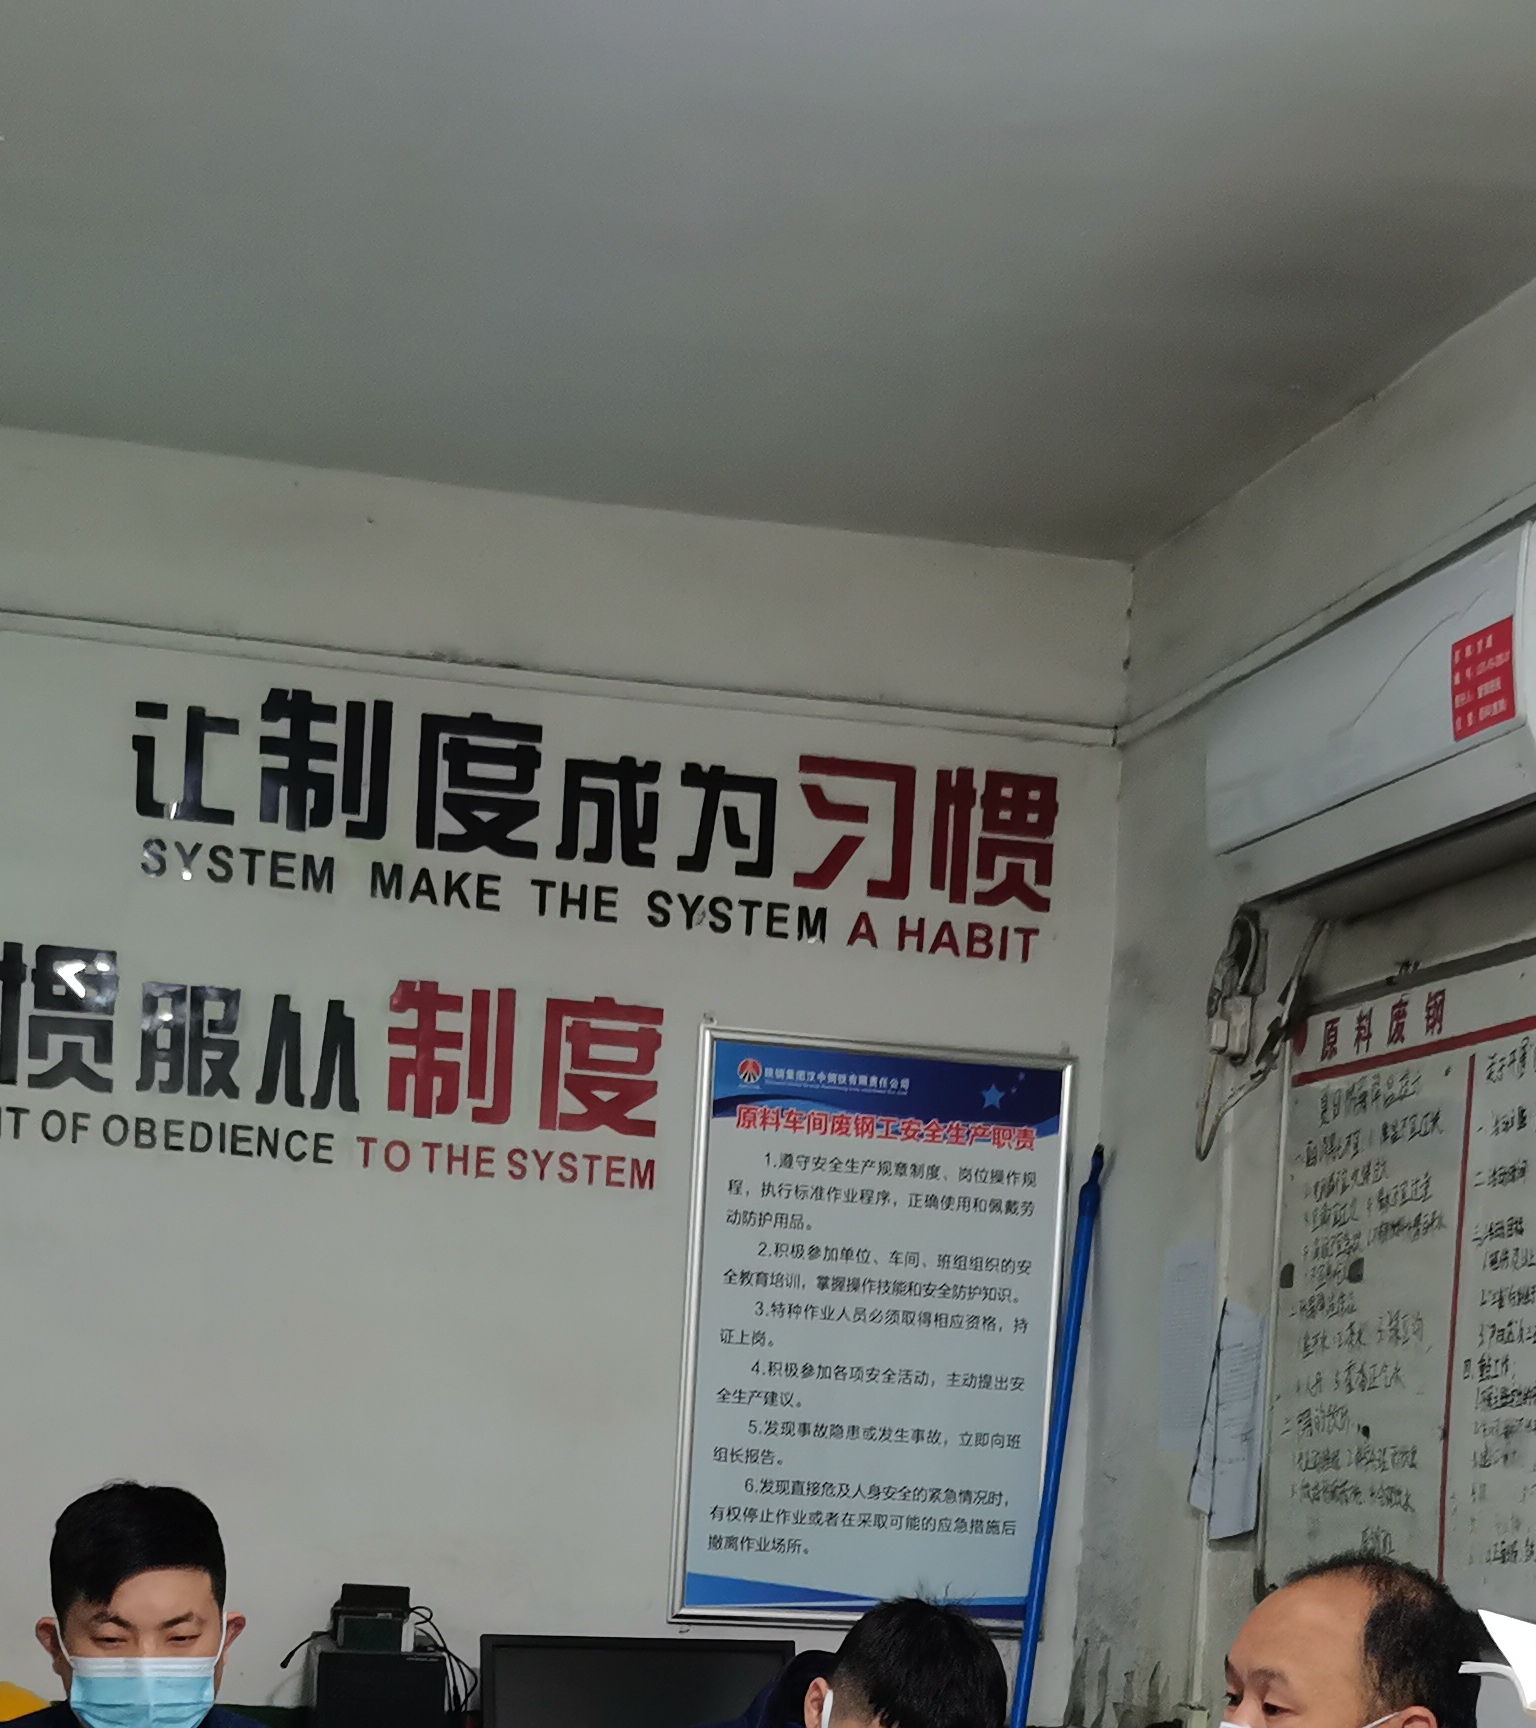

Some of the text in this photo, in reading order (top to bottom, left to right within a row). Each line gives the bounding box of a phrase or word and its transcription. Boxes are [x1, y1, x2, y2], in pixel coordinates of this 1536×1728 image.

[132, 688, 1059, 915] 让制度成为习惯
[141, 836, 1040, 963] SYSTEM MAKE THE SYSTEM A HABIT
[736, 1105, 1037, 1152] 原料车间废钢工安全生产职责
[40, 1110, 92, 1142] OF
[101, 1115, 335, 1167] OBEDIENCE
[355, 1137, 413, 1172] TO
[421, 1140, 500, 1180] THE
[507, 1148, 657, 1191] SYSTEM
[725, 1208, 814, 1232] 动防护用品。
[719, 1327, 775, 1348] 证上岗。
[750, 1358, 1025, 1392] 4.积极参加各项安全活动，主动提出安
[715, 1387, 803, 1409] 全生产建议。
[748, 1419, 1022, 1451] 5.发现事故隐患或发生事故，立即向班
[712, 1446, 785, 1467] 组长报告。
[709, 1506, 1018, 1537] 有权停止作业或者在采取可能的应急措施后
[707, 1536, 810, 1556] 撤离作业场所。
